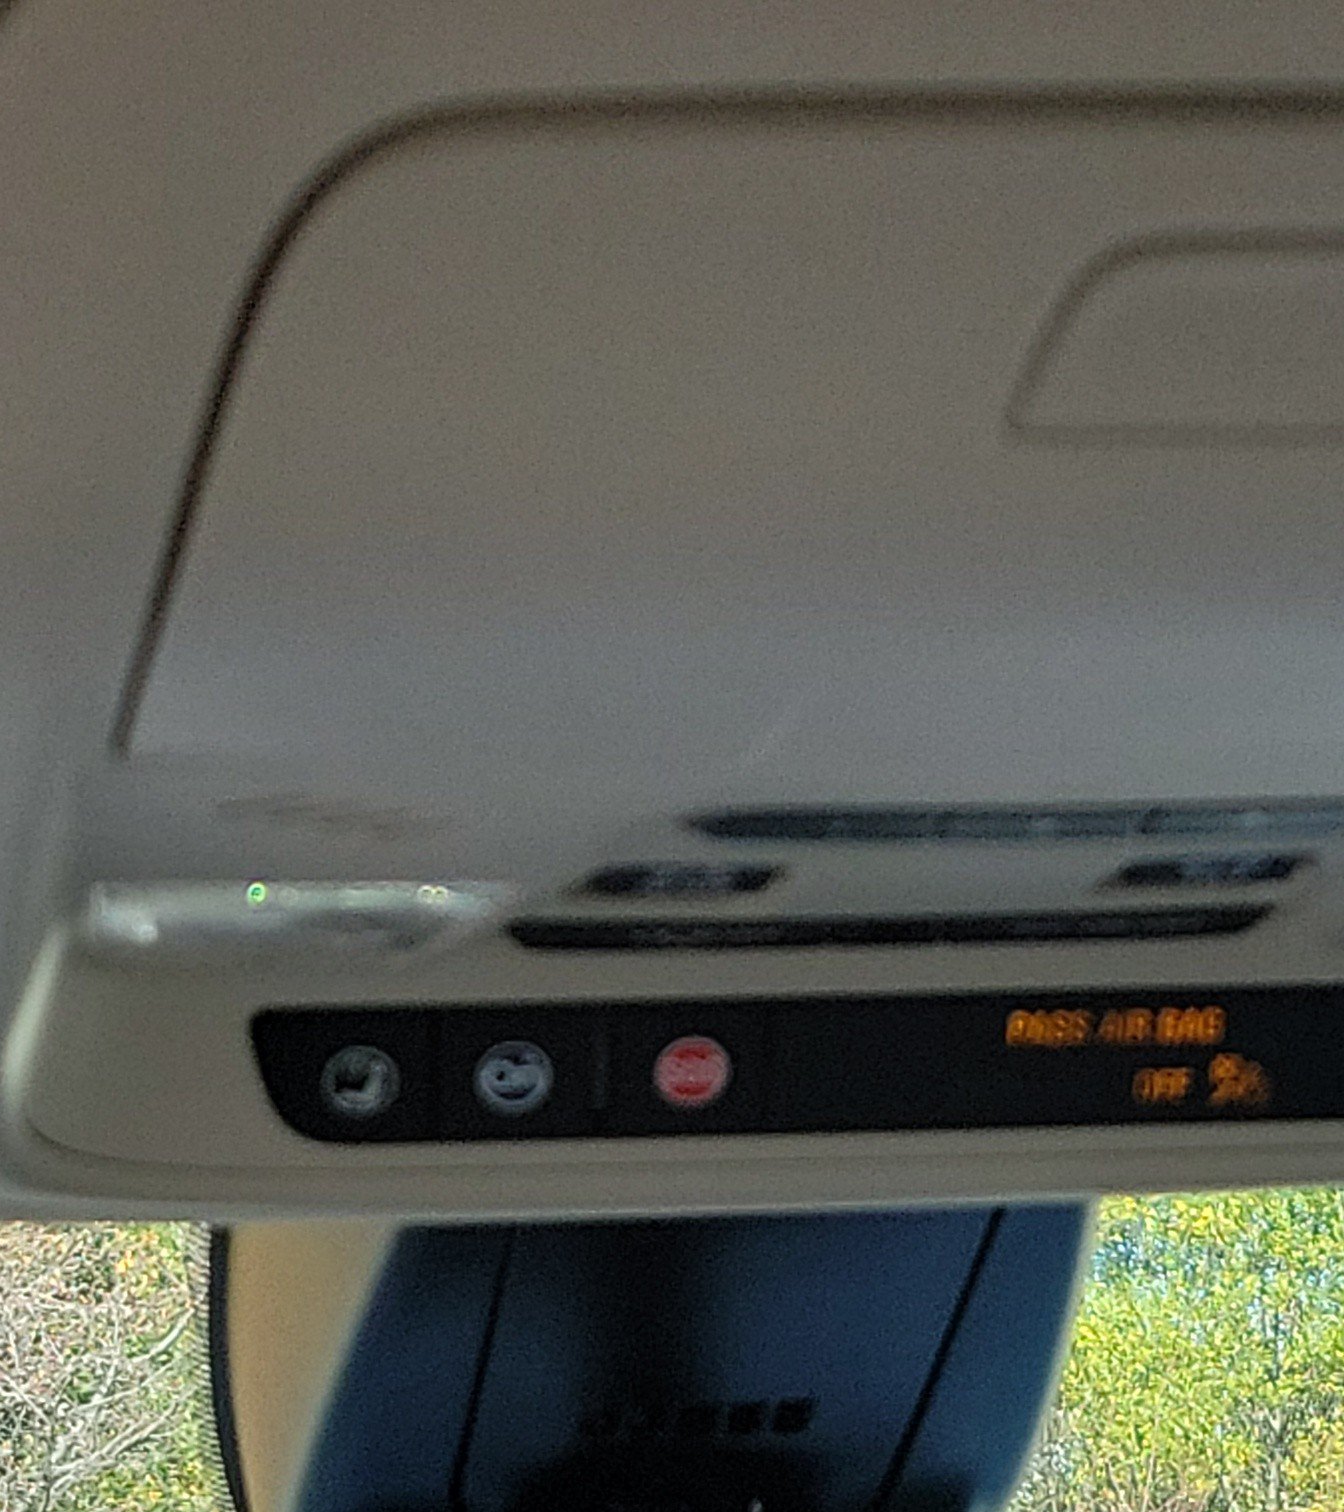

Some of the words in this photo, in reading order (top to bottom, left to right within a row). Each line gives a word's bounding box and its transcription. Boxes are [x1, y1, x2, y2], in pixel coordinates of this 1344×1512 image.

[1006, 1008, 1093, 1045] PASS
[1097, 1007, 1155, 1044] AIR
[1156, 1005, 1226, 1044] BAG
[1132, 1066, 1193, 1103] OFF
